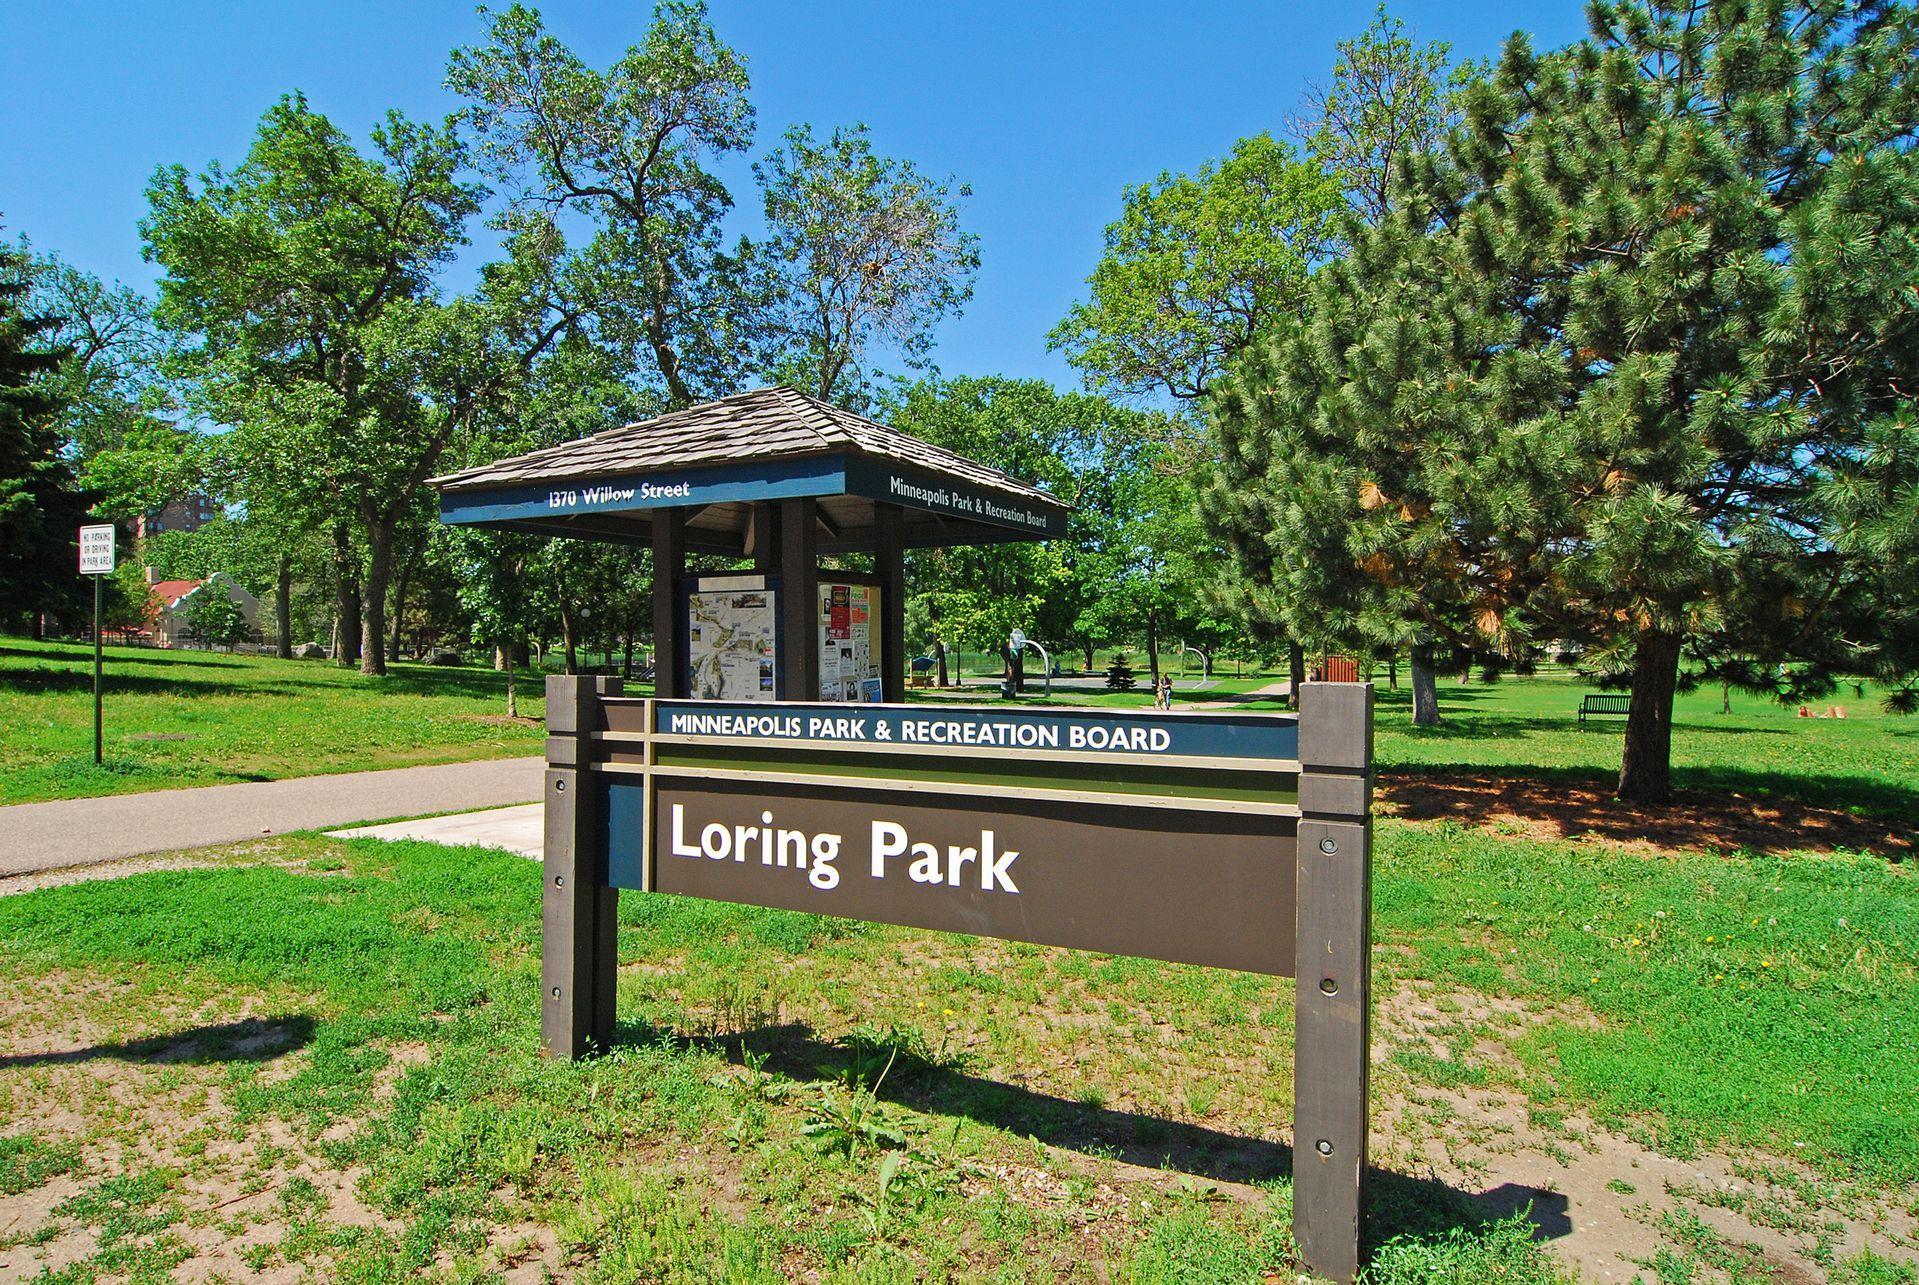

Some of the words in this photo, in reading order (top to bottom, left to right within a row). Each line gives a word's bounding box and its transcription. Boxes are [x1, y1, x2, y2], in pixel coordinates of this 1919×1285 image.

[549, 490, 577, 508] 1370
[582, 487, 635, 505] Willow
[641, 481, 690, 499] Street
[890, 476, 949, 506] Minneapolis
[952, 492, 973, 512] Park
[975, 498, 983, 514] &
[985, 501, 1025, 523] Recreation
[1027, 511, 1047, 528] Board
[91, 532, 111, 542] PARKING
[91, 544, 110, 554] DRIVING
[100, 556, 112, 565] AREA
[671, 714, 801, 737] MINNEAPOLIS
[809, 718, 867, 740] PARK
[874, 719, 892, 741] &
[901, 721, 1060, 746] RECREATION
[1069, 727, 1171, 750] BOARD
[672, 804, 842, 890] Loring
[871, 820, 1020, 894] Park
